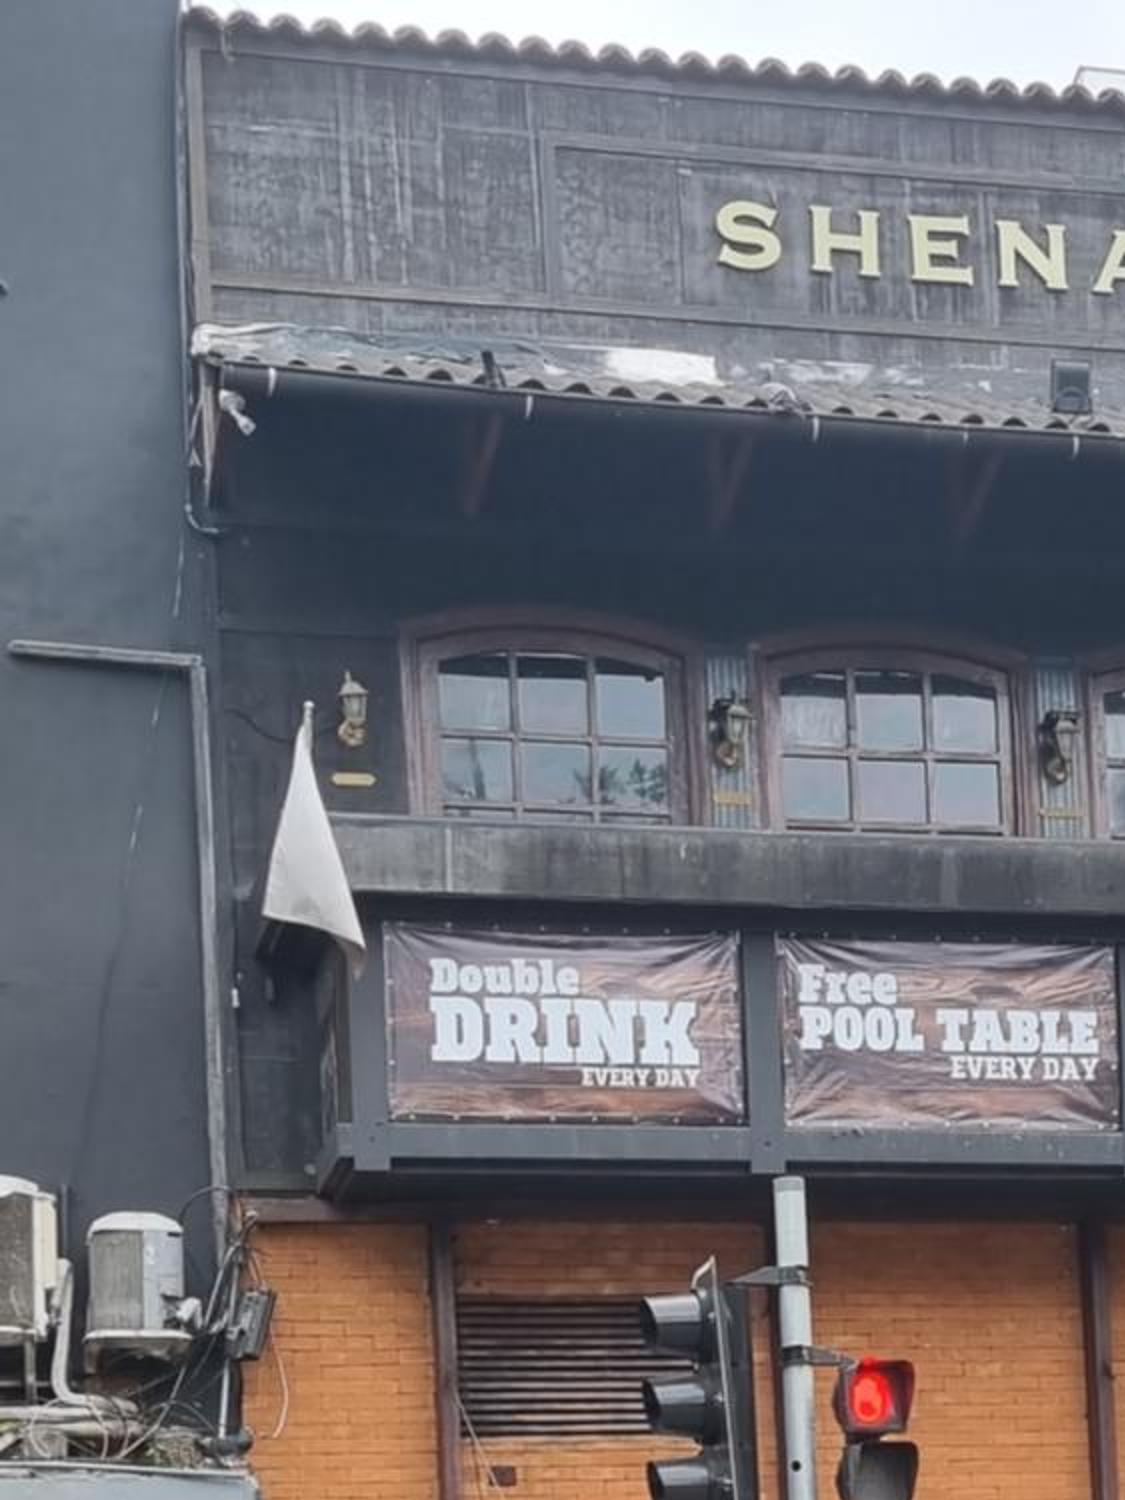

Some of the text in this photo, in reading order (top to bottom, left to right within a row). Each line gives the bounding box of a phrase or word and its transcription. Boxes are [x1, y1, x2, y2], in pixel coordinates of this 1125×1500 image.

[429, 957, 579, 995] Double
[799, 964, 897, 1005] Free
[430, 997, 700, 1066] DRINK
[800, 1006, 1099, 1054] POOL TABLE
[582, 1068, 700, 1088] EVERY DAY
[951, 1056, 1099, 1080] EVERY DAY
